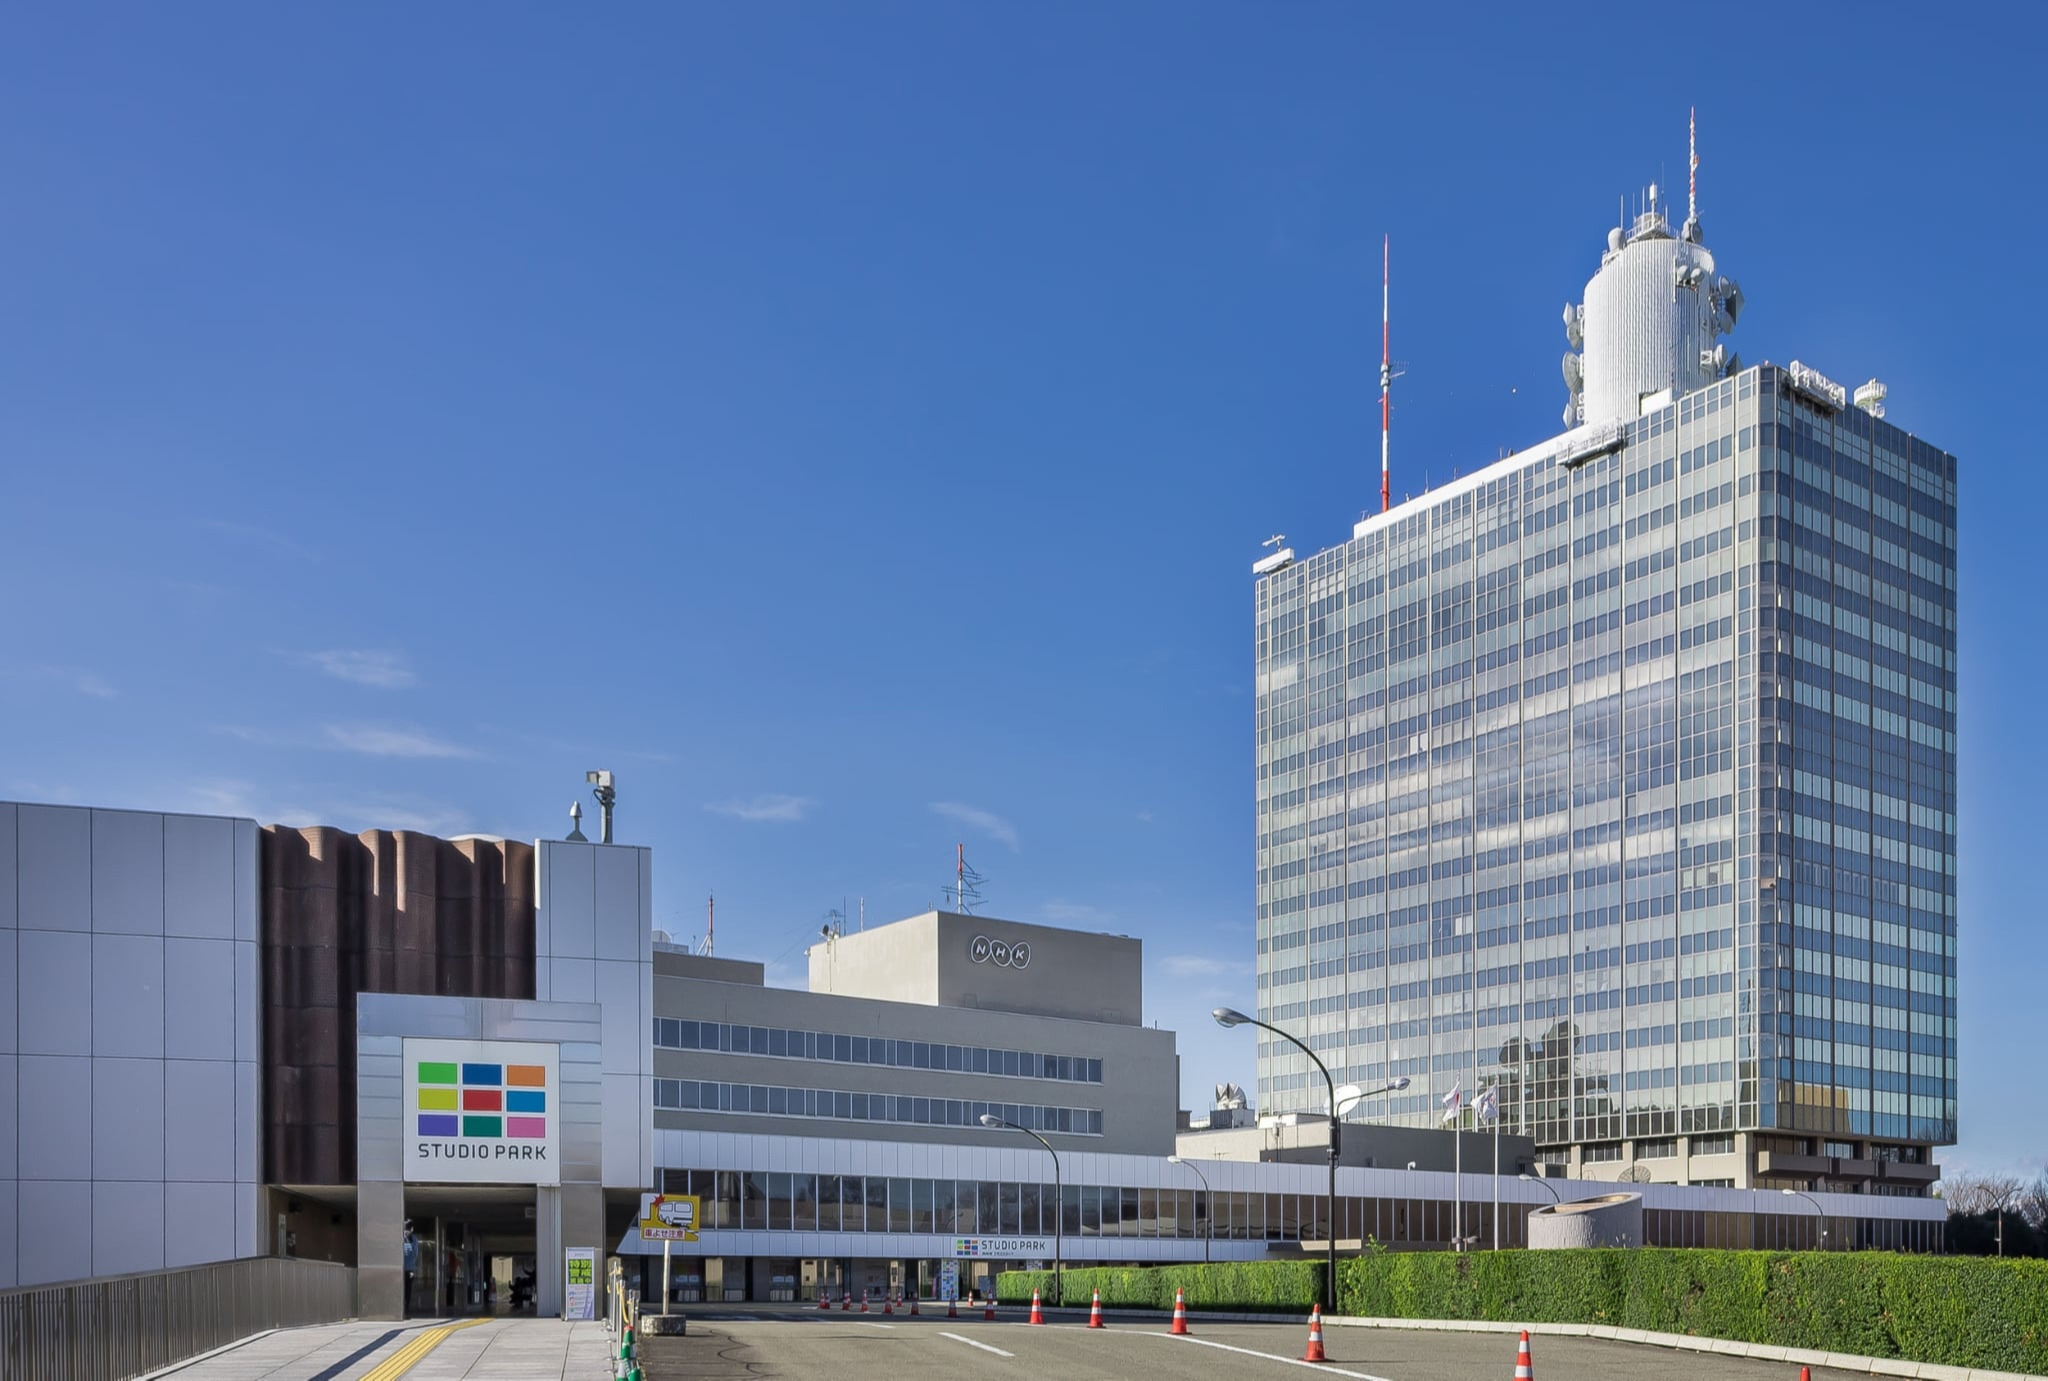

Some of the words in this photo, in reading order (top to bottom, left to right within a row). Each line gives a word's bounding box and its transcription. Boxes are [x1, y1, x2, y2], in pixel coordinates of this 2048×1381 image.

[418, 1143, 489, 1159] STUDIO
[495, 1145, 547, 1160] PARK
[981, 1240, 1017, 1250] STUDIO
[1019, 1240, 1046, 1251] PARK
